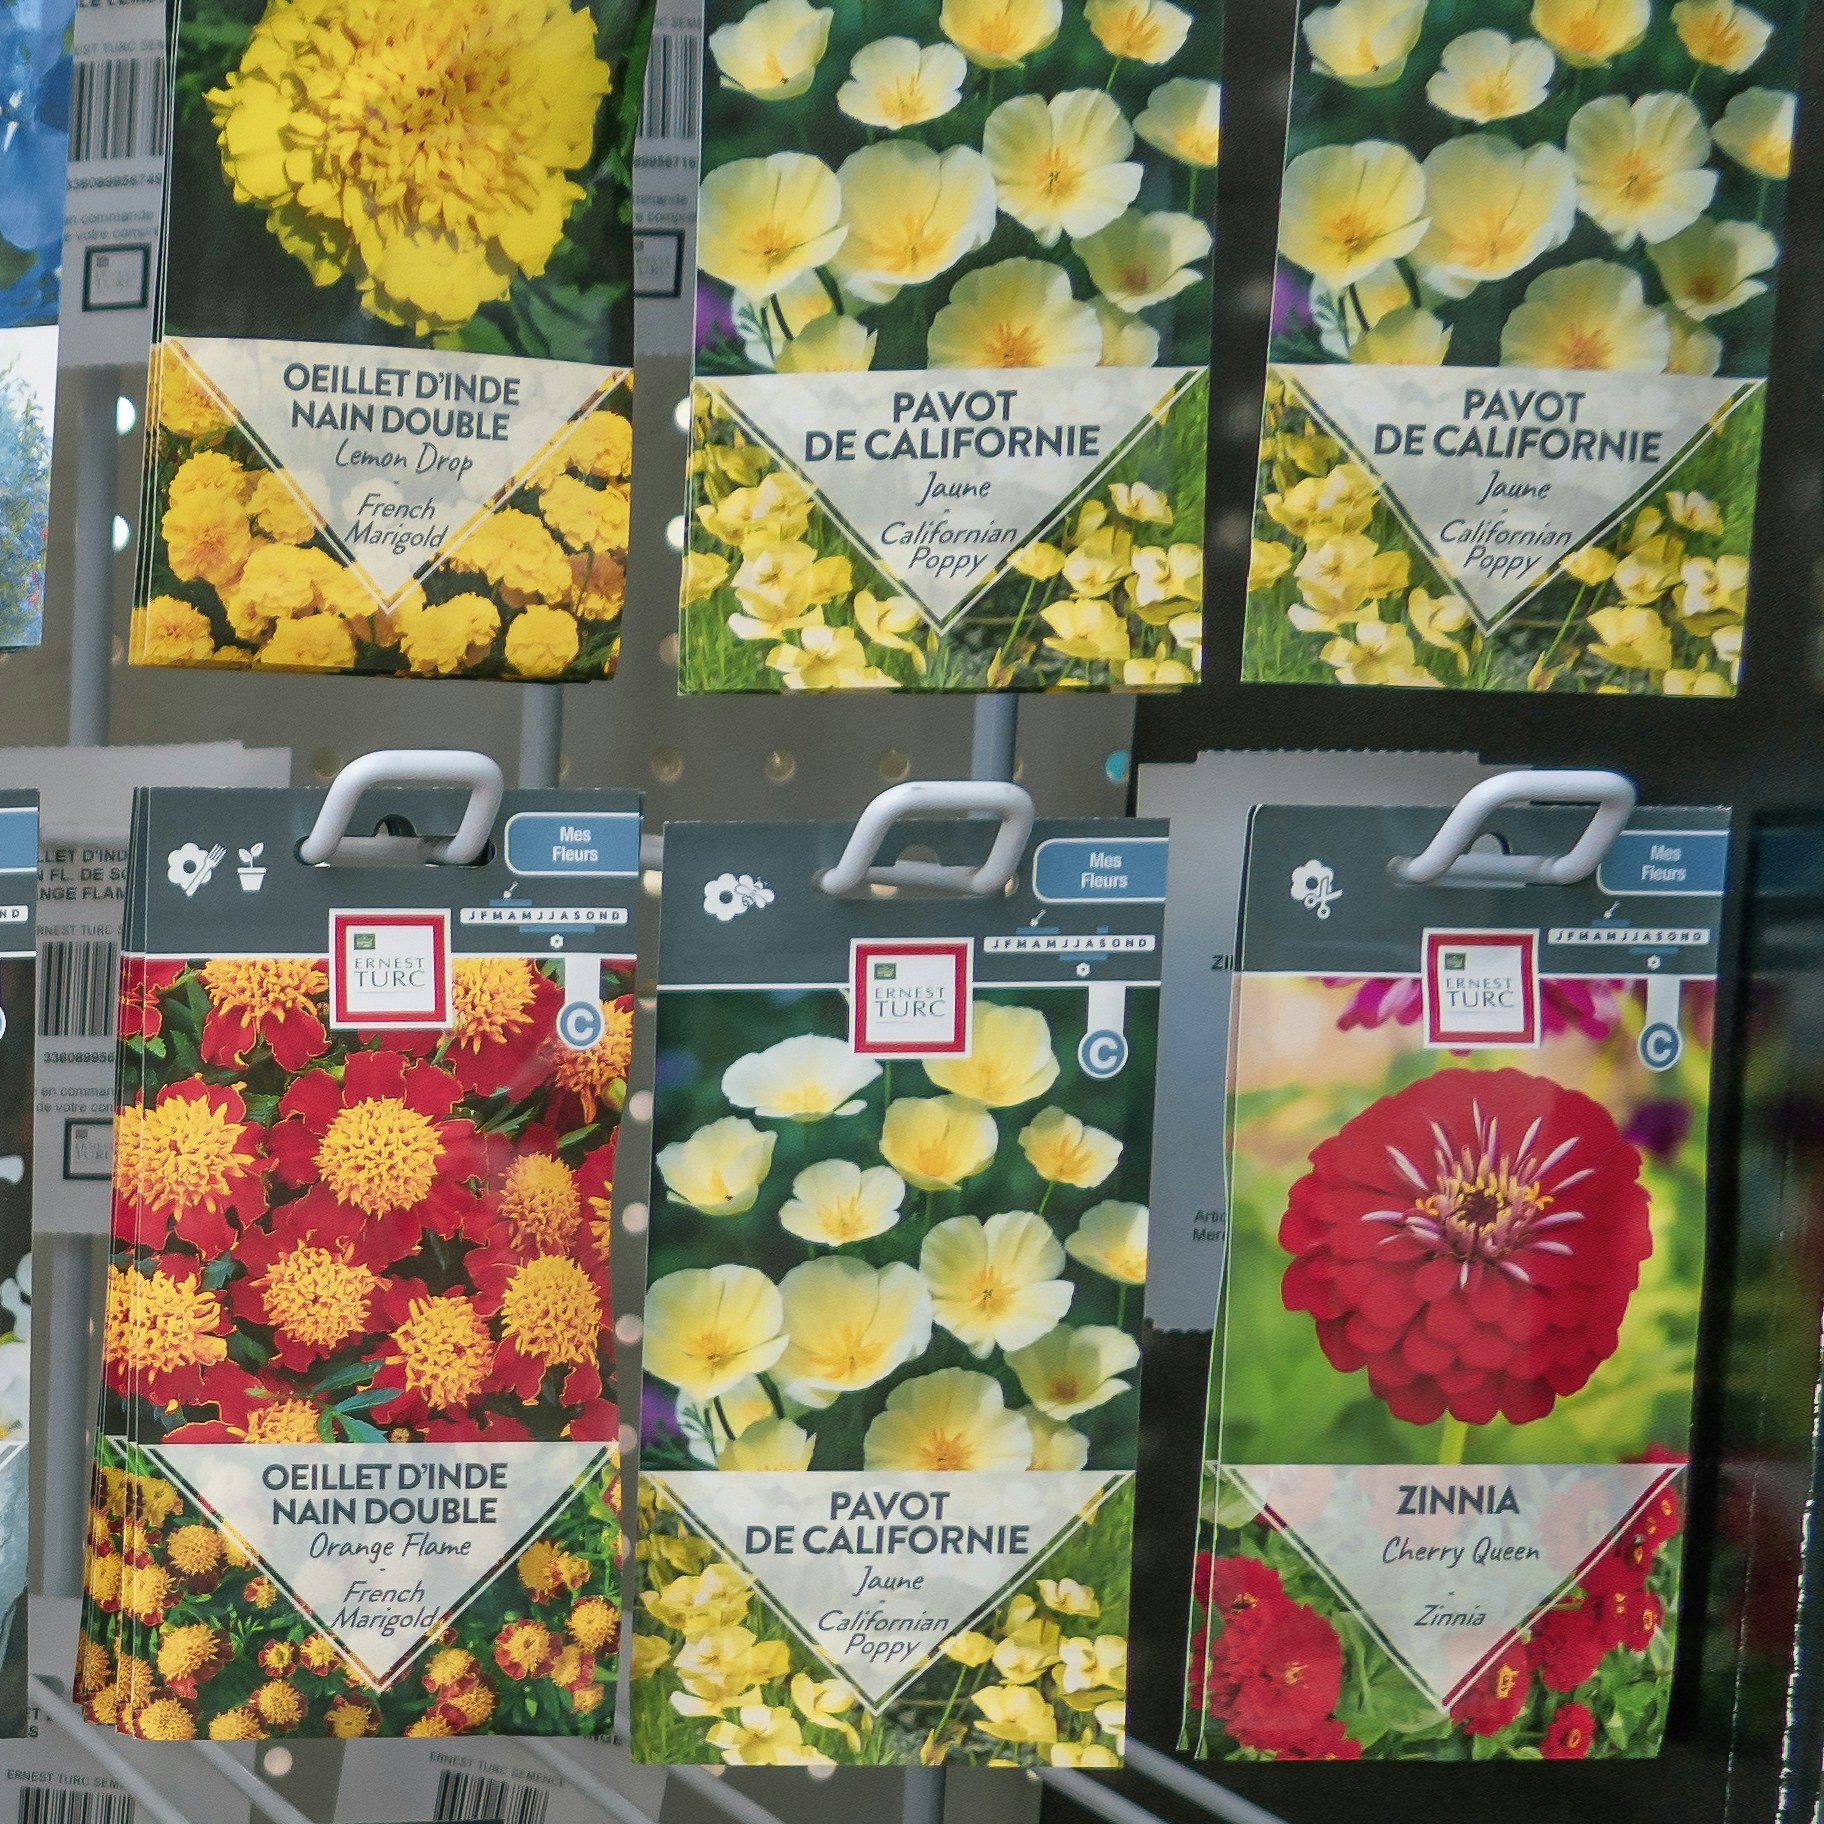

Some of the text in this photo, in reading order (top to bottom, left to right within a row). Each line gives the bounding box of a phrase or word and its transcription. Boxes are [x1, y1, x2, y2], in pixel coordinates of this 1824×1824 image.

[283, 363, 520, 405] OEILLET D'INDE
[291, 399, 509, 442] NAIN DOUBLE
[892, 390, 1017, 424] PAVOT
[1461, 389, 1585, 422] PAVOT
[805, 426, 1100, 462] DE CALIFORNIE
[1373, 423, 1662, 464] DE CALIFORNIE
[357, 493, 436, 520] French
[344, 521, 447, 555] Marigold
[881, 519, 1015, 547] Californian
[908, 547, 986, 577] Poppy
[559, 826, 591, 843] Mes
[552, 844, 598, 863] Fleurs
[354, 956, 424, 970] ERNEST
[354, 968, 424, 988] TURC
[262, 1462, 508, 1491] OEILLET D'INDE
[272, 1497, 497, 1525] NAIN DOUBLE
[830, 1490, 949, 1521] PAVOT
[1396, 1485, 1520, 1517] ZINNIA
[745, 1524, 1028, 1556] DE CALIFORNIE
[1381, 1536, 1539, 1567] Cherry Queen
[342, 1582, 425, 1604] French
[332, 1606, 437, 1637] Marigold
